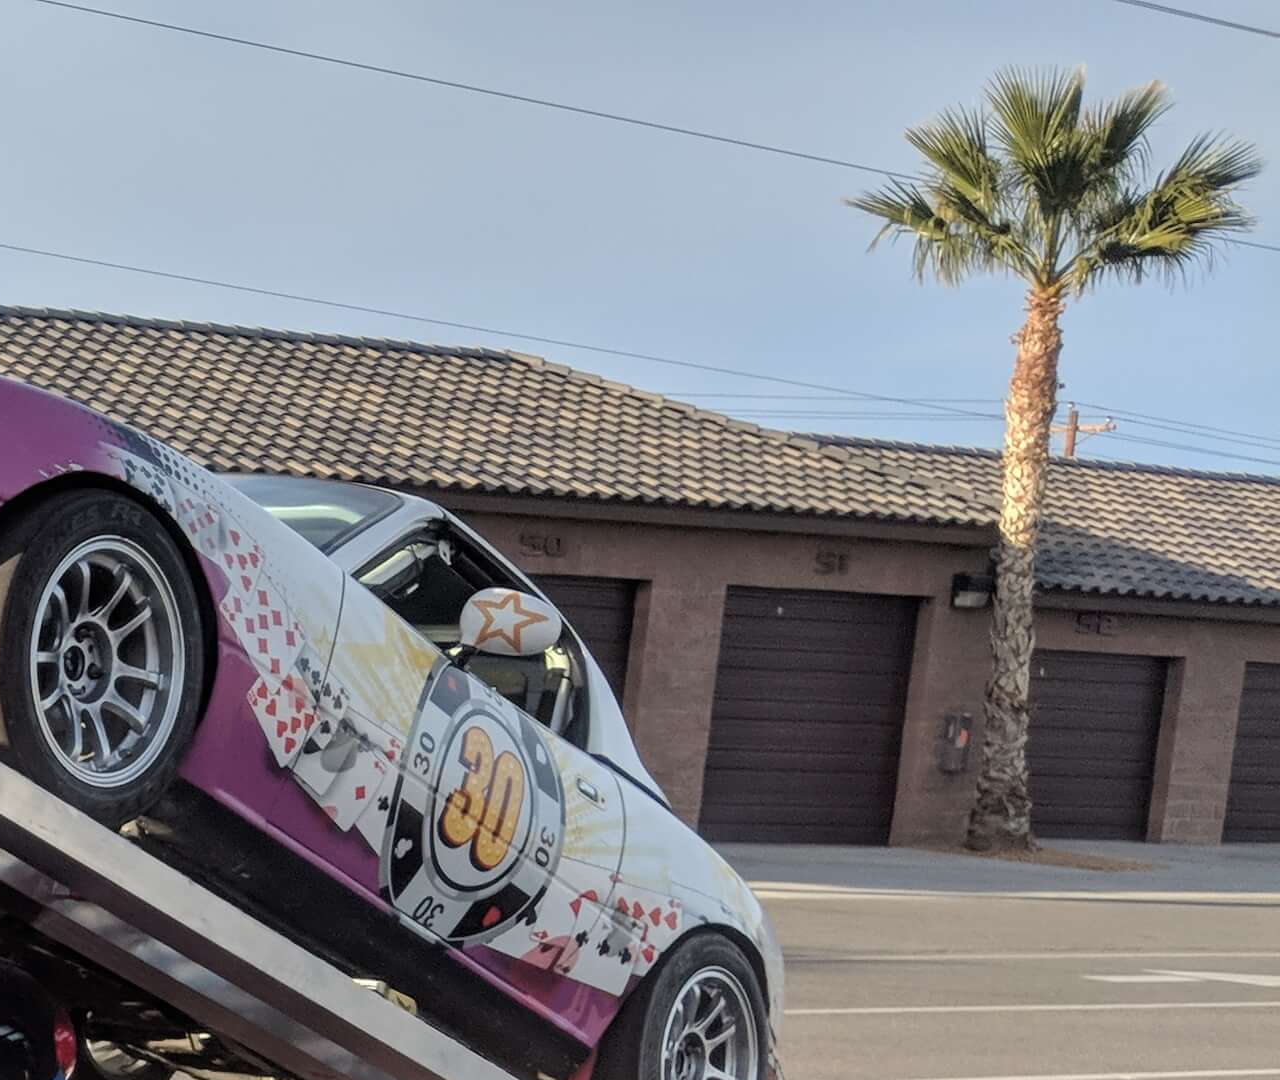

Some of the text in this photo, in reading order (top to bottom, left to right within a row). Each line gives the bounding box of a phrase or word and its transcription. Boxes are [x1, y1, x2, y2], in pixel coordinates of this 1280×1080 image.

[412, 731, 436, 776] 30
[440, 725, 525, 872] 30
[534, 826, 556, 868] 30
